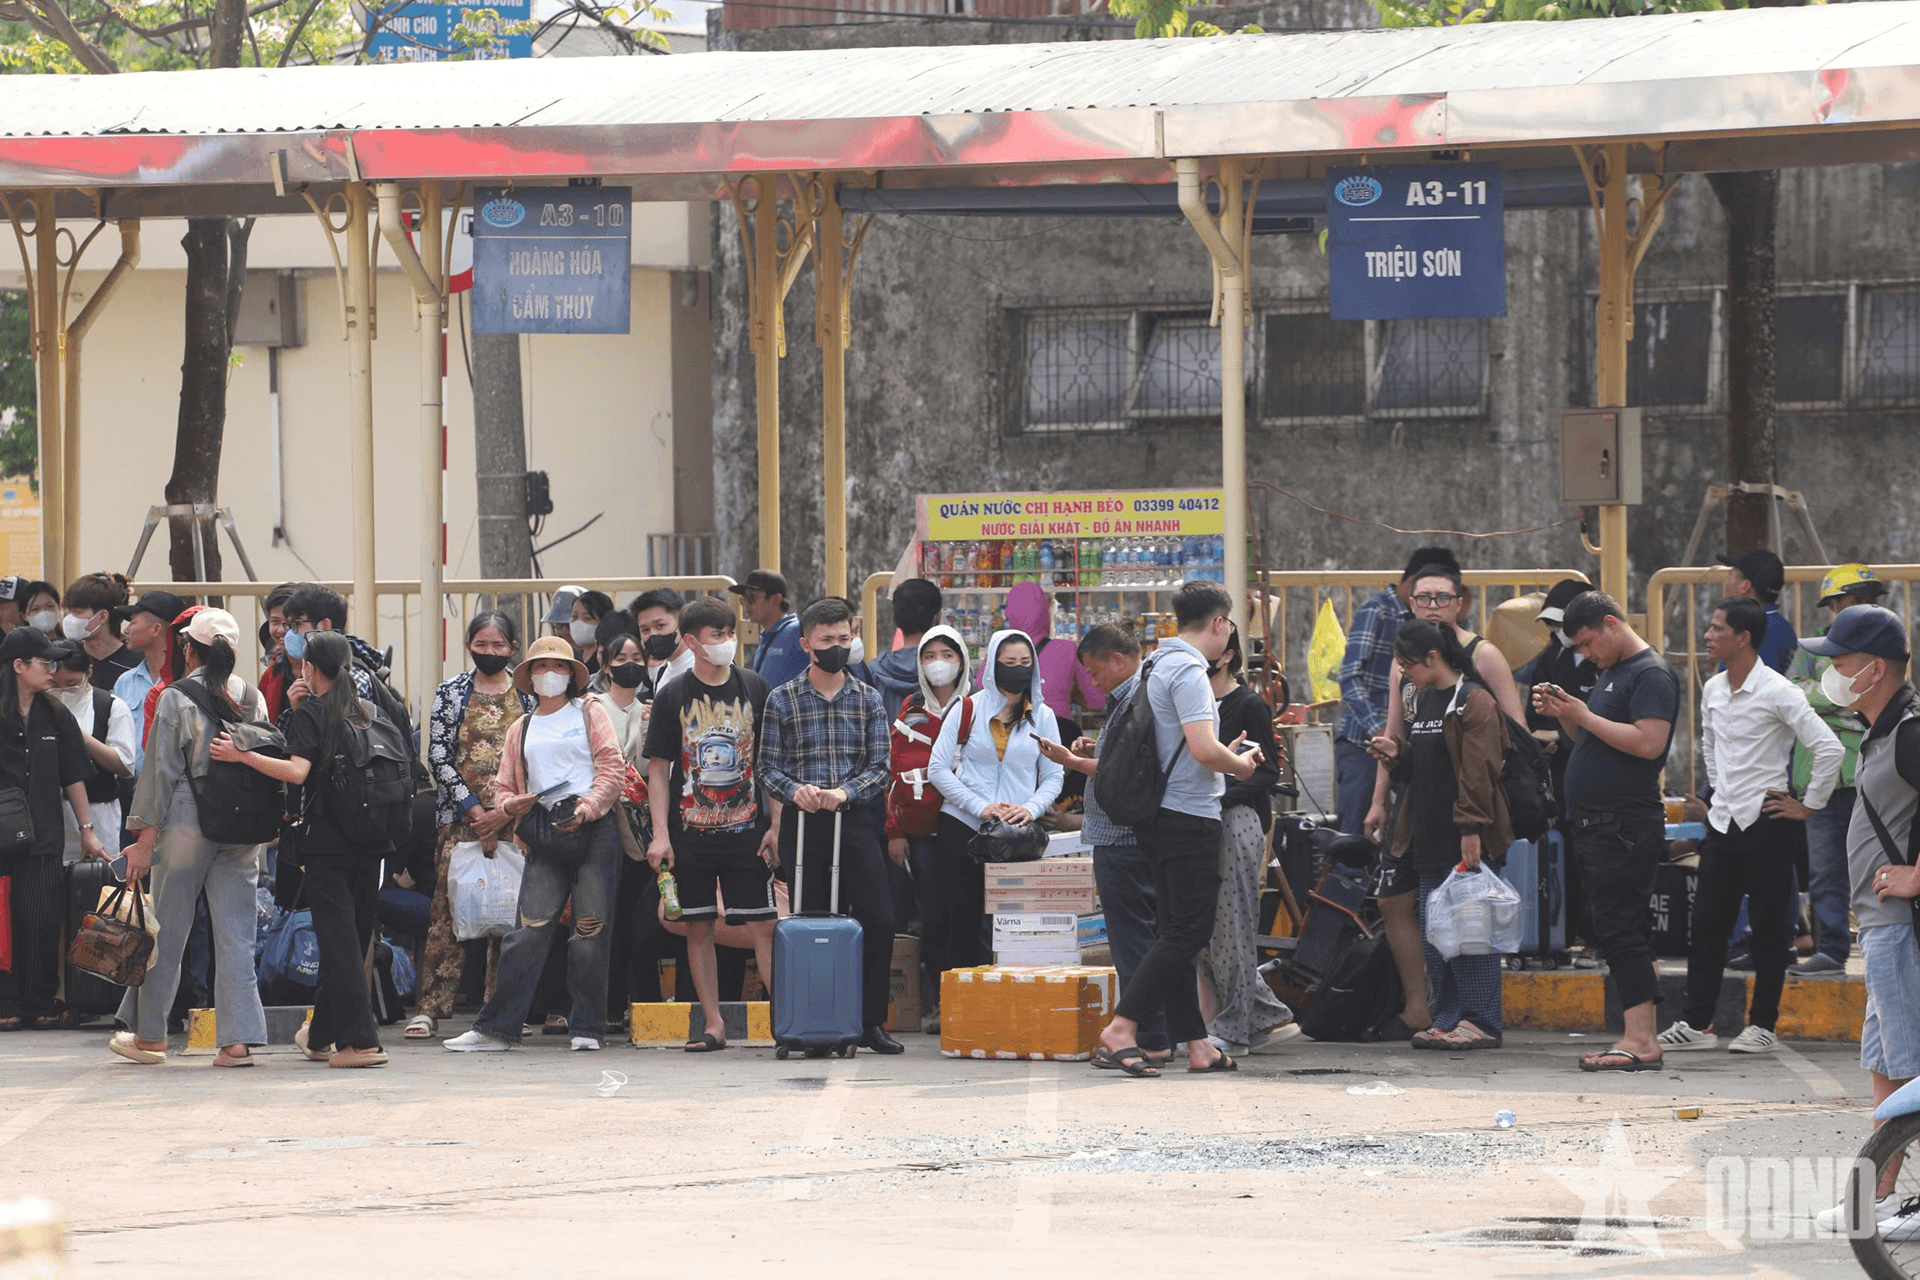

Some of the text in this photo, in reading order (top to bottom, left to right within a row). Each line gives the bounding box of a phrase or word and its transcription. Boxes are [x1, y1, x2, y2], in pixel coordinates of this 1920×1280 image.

[413, 16, 437, 34] CHO
[1344, 189, 1373, 200] HNB
[1405, 181, 1487, 206] A3-11
[540, 203, 624, 227] A3-10
[509, 244, 603, 276] HOÀNG HÓA
[1365, 244, 1462, 283] TRIỆU SƠN
[940, 500, 979, 519] QUÁN
[983, 499, 1022, 515] NƯỚC
[1025, 502, 1049, 517] CHỊ
[1052, 500, 1093, 517] HẠNH
[1134, 499, 1174, 512] 03399
[1178, 498, 1219, 511] 40412
[981, 520, 1016, 536] NƯỚC
[1019, 519, 1045, 535] GIẢI
[1136, 519, 1180, 533] NHANH
